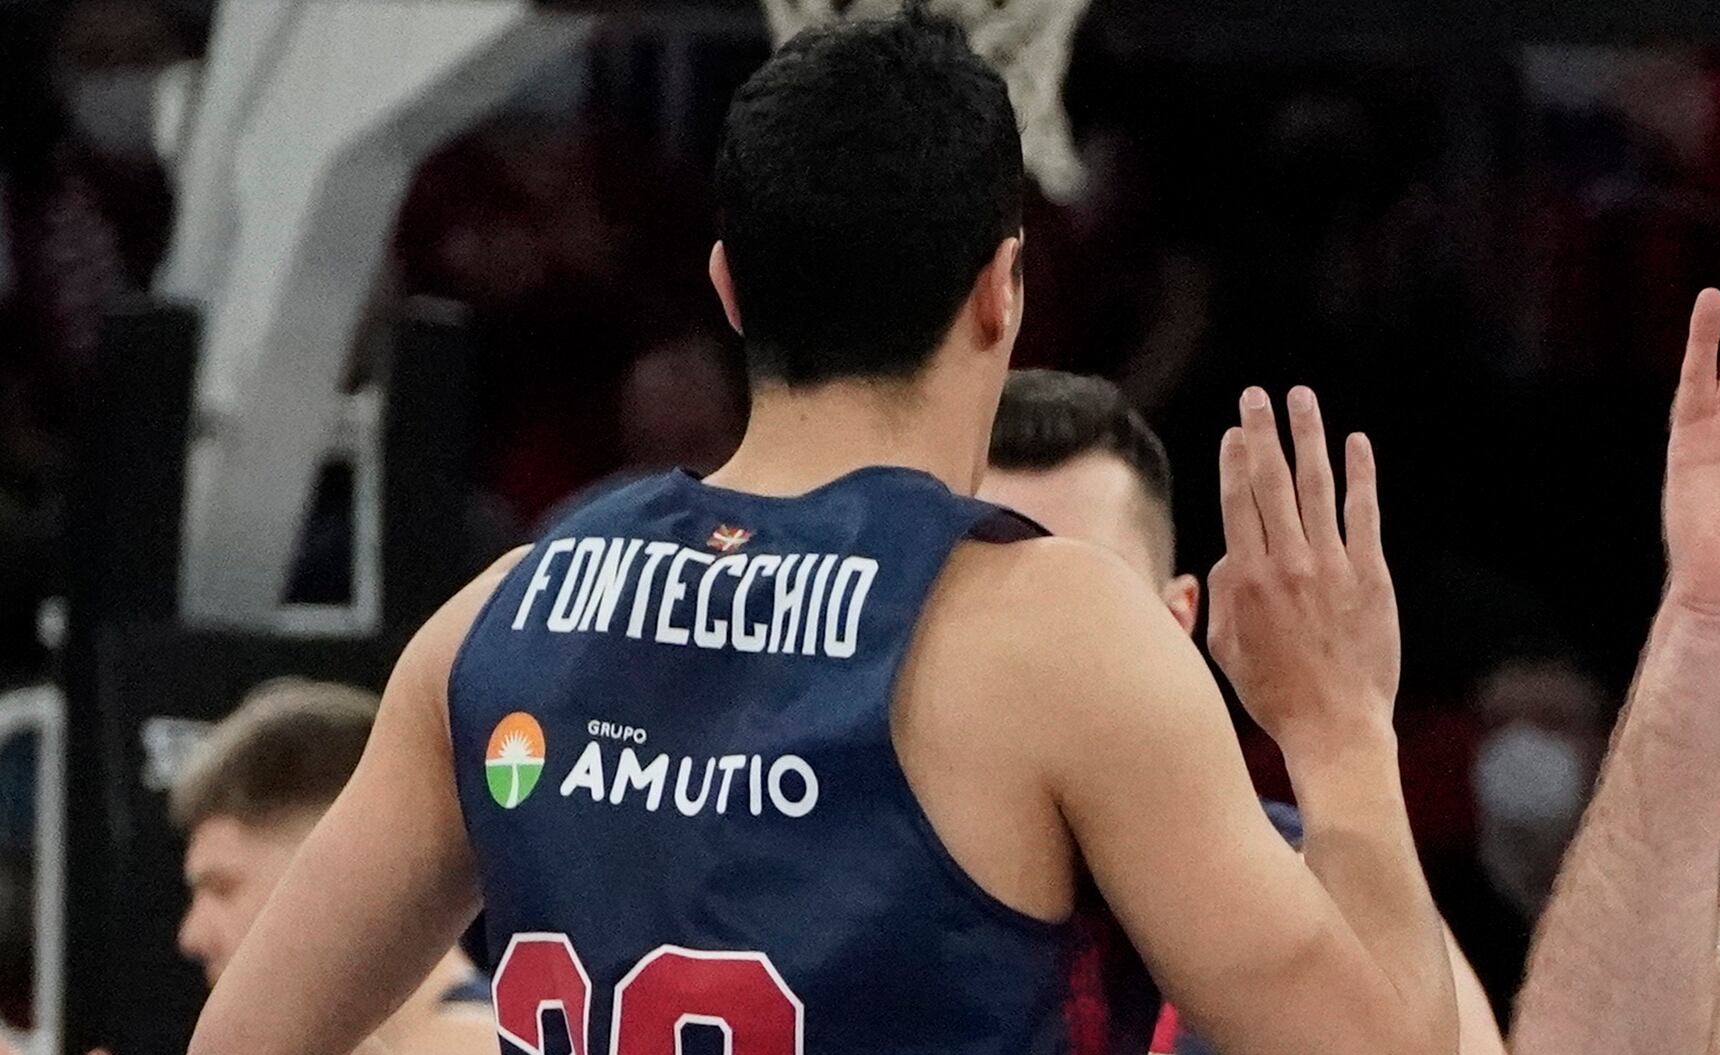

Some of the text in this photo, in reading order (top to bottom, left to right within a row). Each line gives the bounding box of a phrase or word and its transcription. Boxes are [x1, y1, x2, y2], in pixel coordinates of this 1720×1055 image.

[511, 537, 878, 658] FONTECCHIO
[587, 719, 647, 744] GRUPO
[560, 740, 819, 817] AMUTIO
